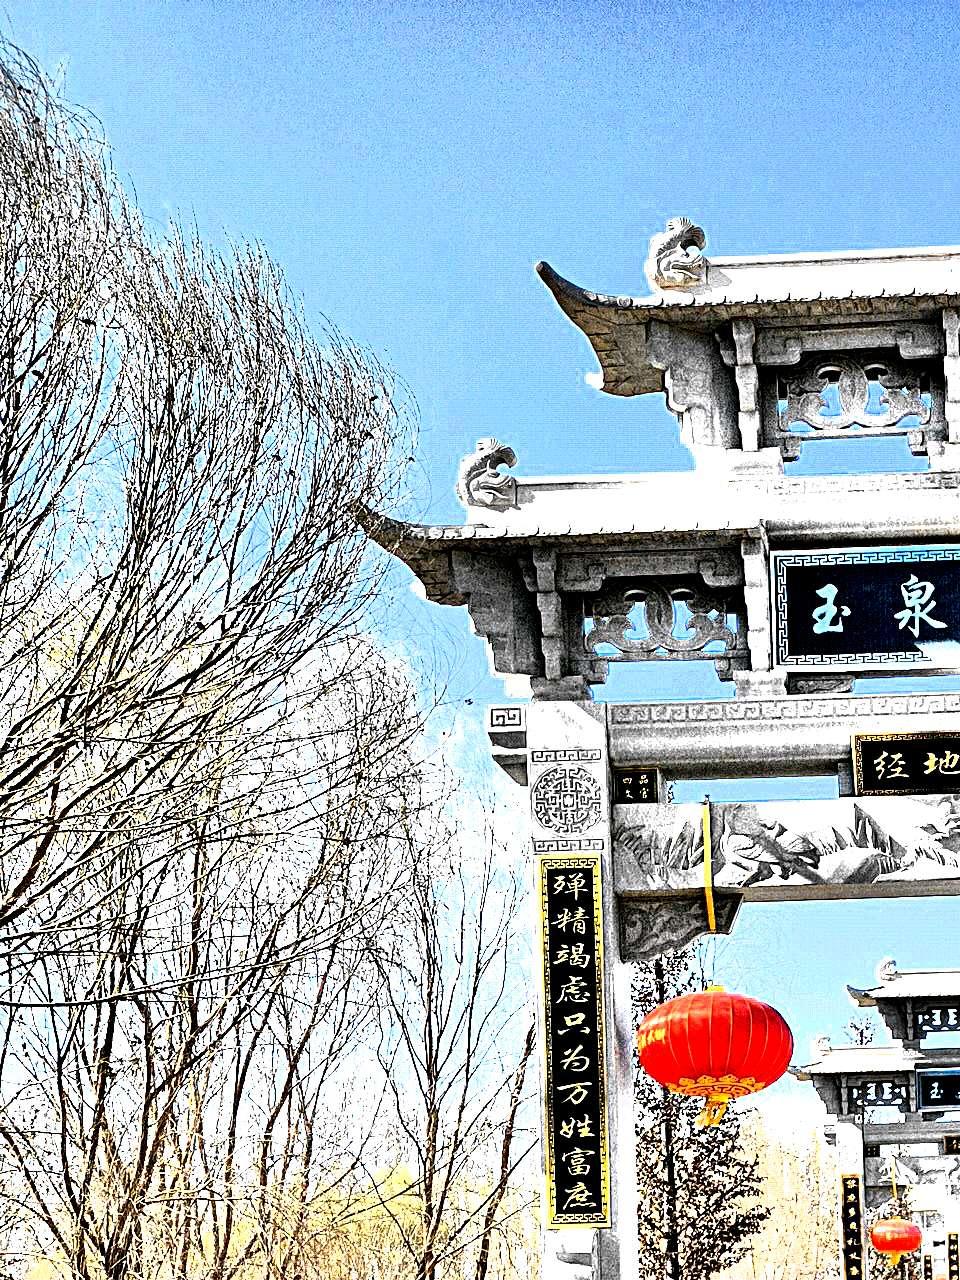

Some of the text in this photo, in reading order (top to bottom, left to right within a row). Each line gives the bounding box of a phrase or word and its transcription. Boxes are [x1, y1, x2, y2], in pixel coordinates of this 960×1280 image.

[551, 872, 597, 1210] 殚精竭虑只为万姓富庶
